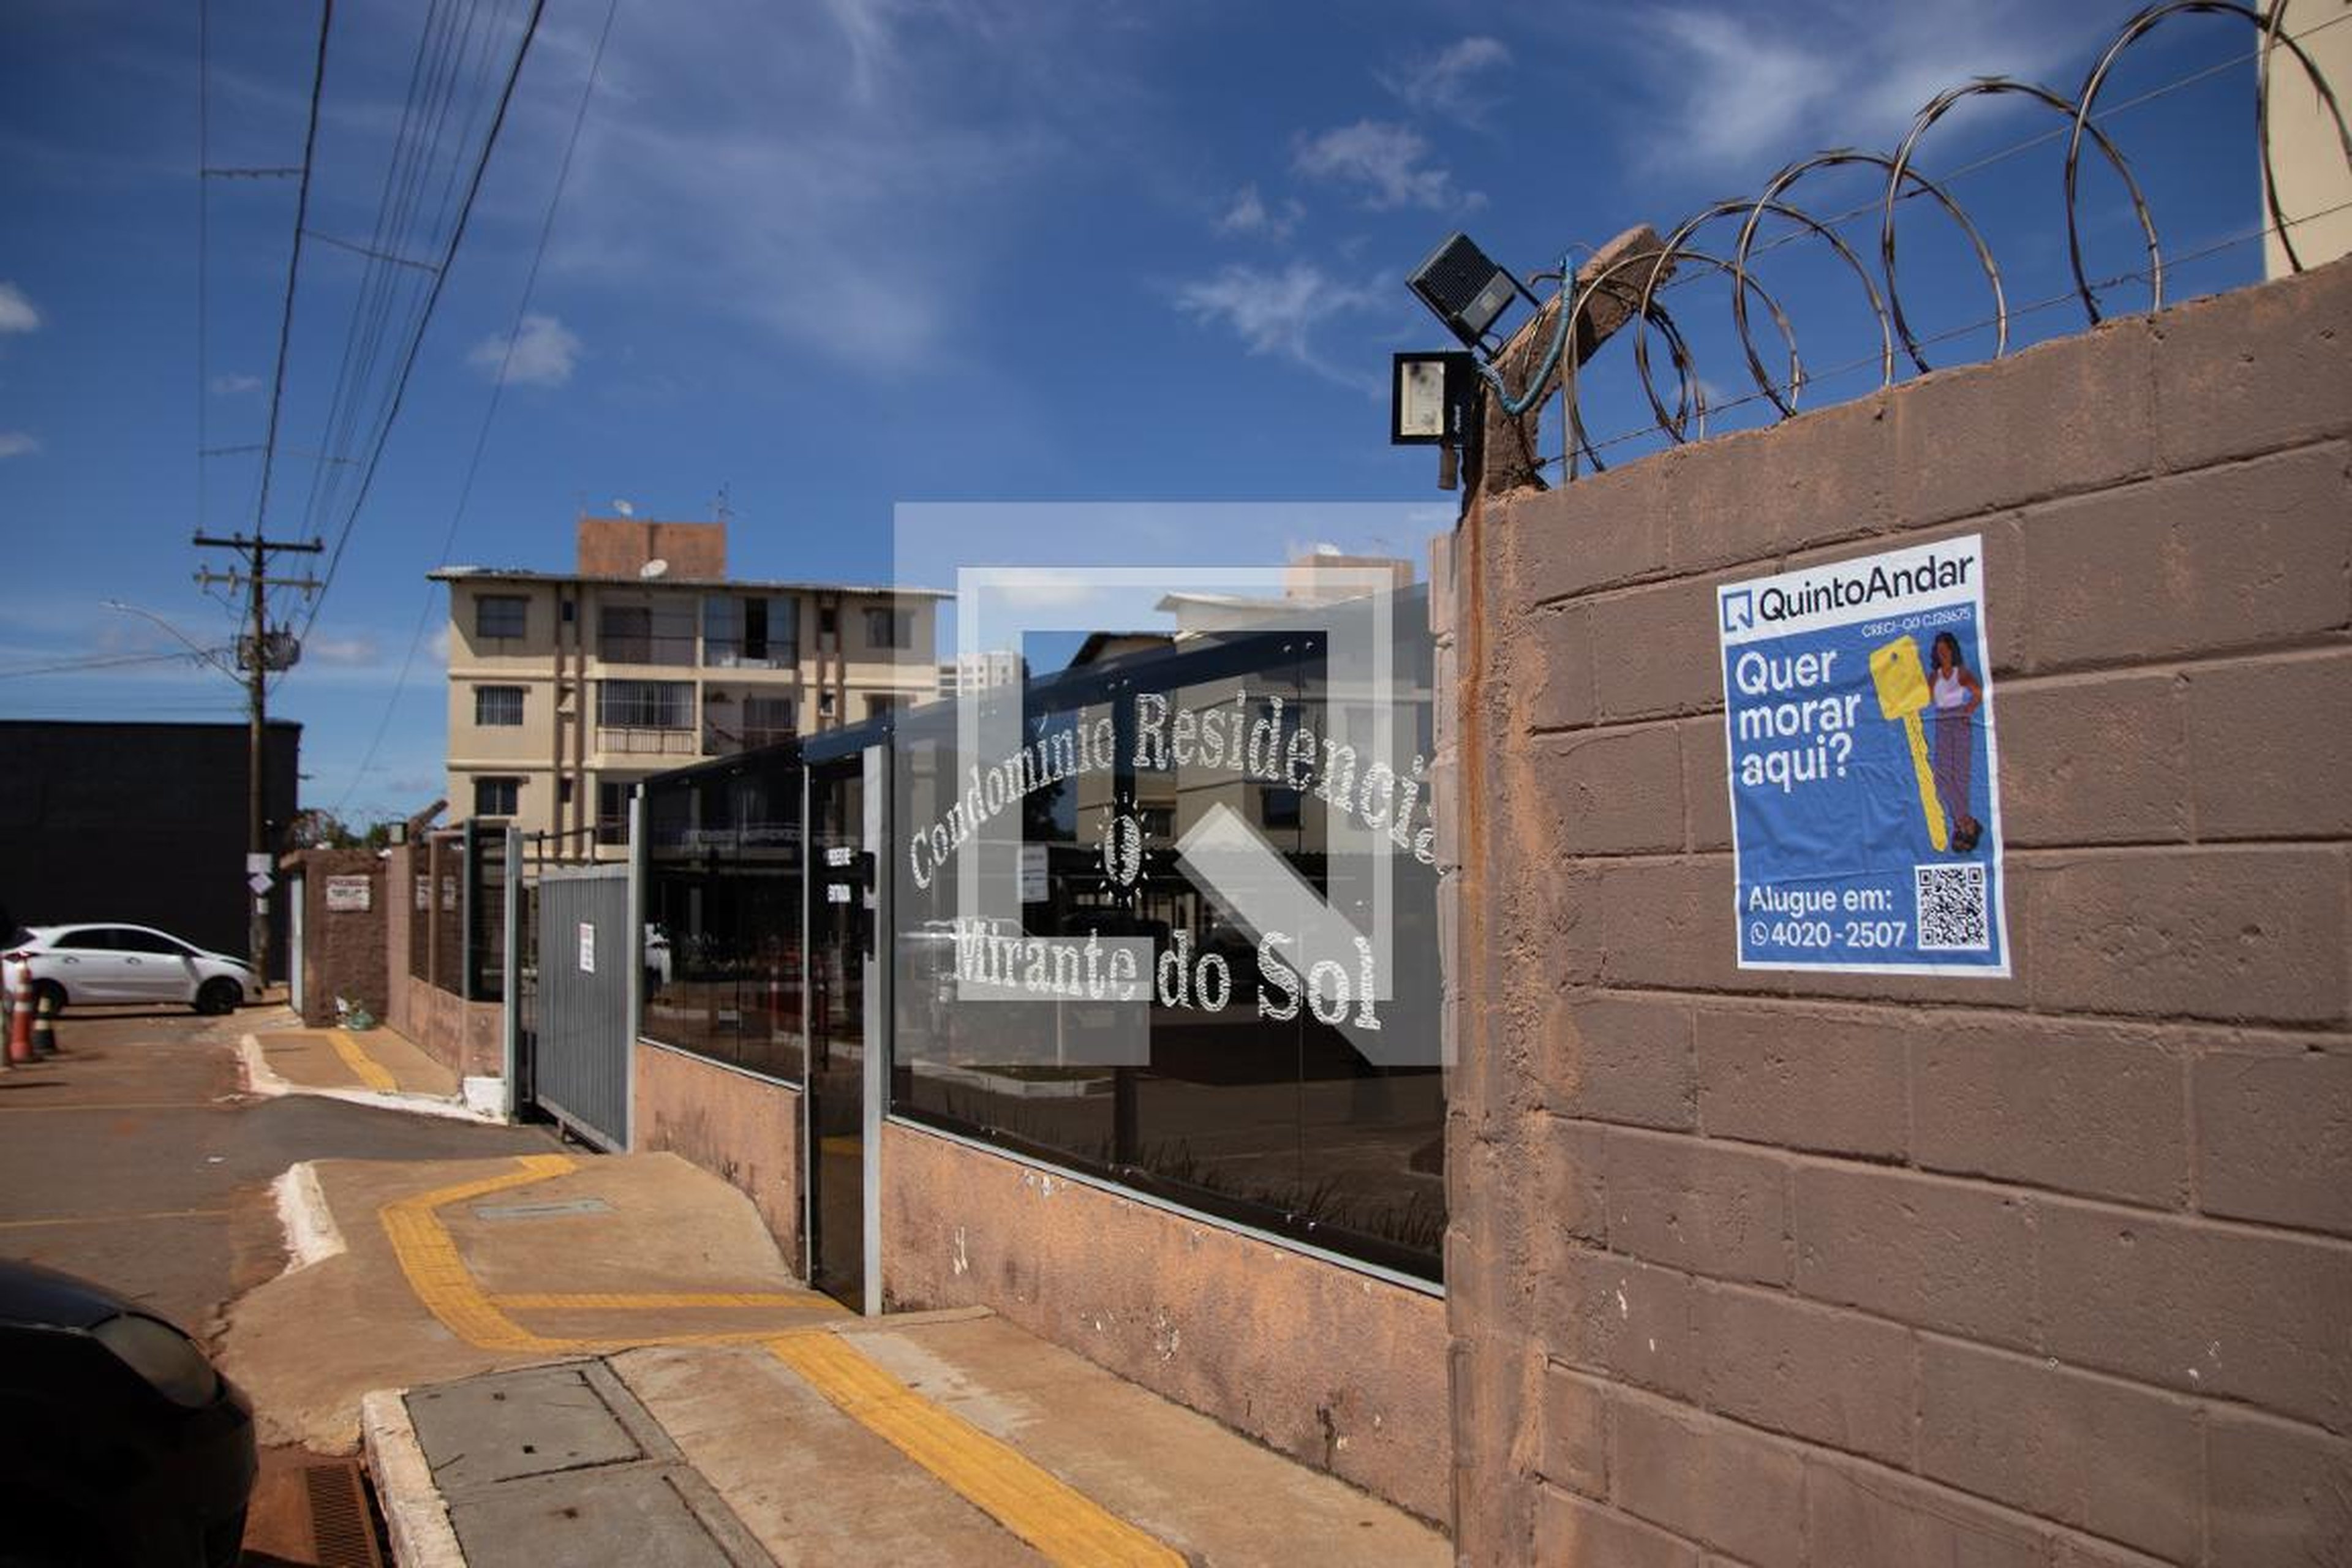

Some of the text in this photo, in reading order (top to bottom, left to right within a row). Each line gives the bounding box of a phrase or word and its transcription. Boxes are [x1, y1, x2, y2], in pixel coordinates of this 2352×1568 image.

[1760, 556, 1974, 621] QuintoAndar
[1735, 650, 1837, 695] Quer
[1740, 693, 1861, 741] morar
[1133, 690, 1434, 865] Residencia
[1741, 732, 1853, 793] aqui?
[1749, 886, 1893, 918] Alugue em:
[954, 917, 1381, 1030] Mirante do Sol
